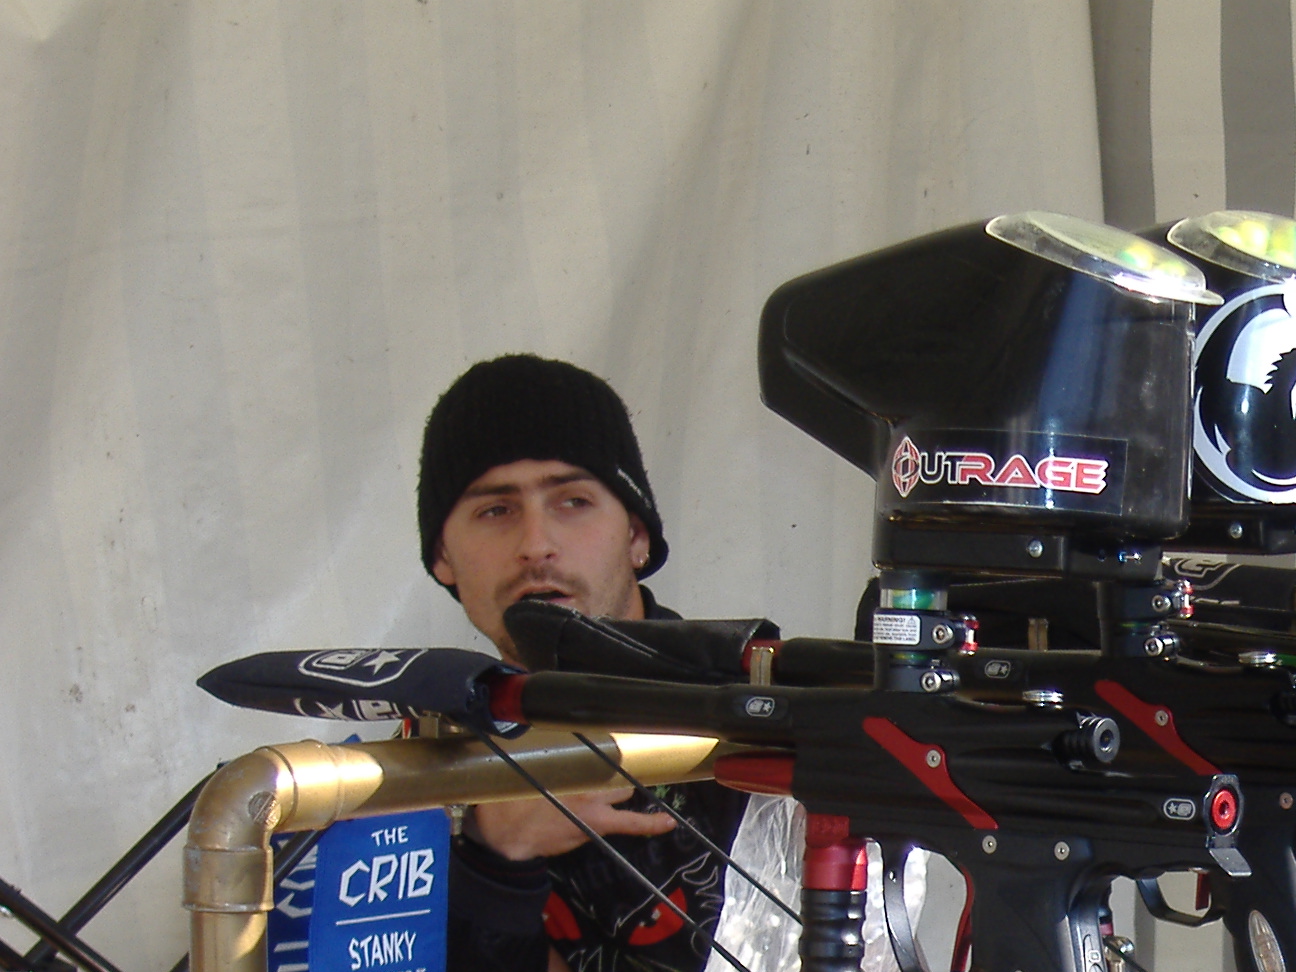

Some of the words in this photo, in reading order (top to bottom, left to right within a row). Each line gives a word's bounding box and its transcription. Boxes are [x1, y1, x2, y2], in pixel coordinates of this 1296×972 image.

[892, 436, 1109, 498] OUTRAGE
[371, 826, 410, 847] THE
[339, 848, 435, 907] CRIB
[348, 930, 417, 971] STANKY
